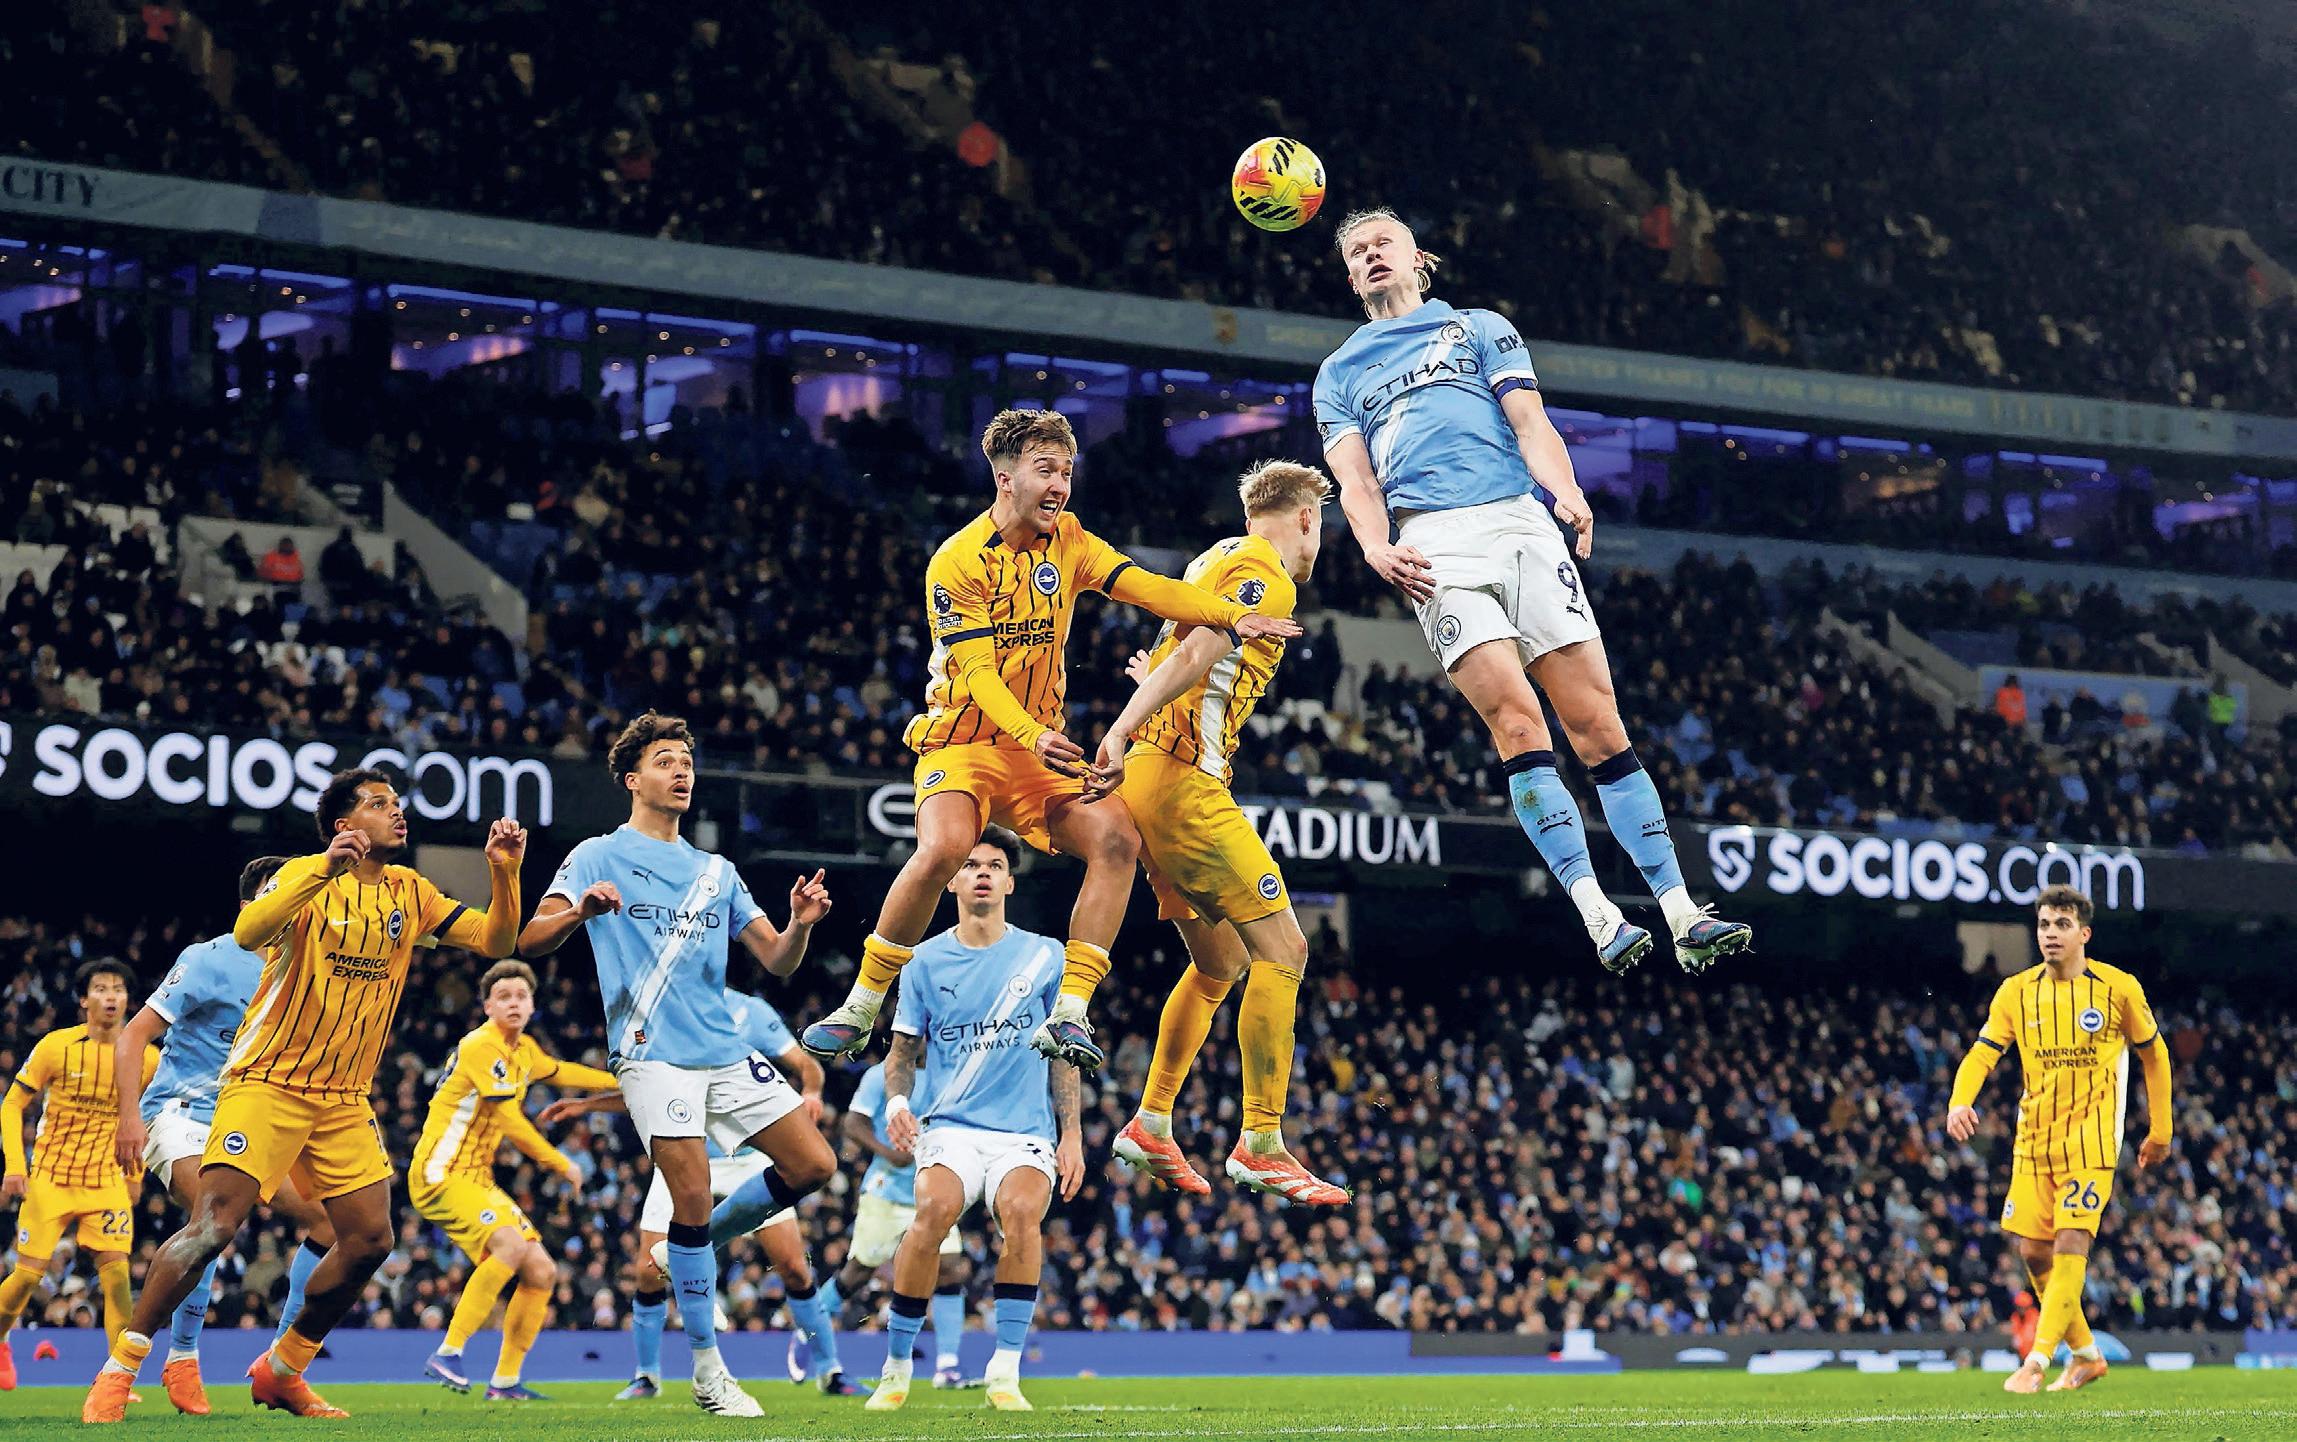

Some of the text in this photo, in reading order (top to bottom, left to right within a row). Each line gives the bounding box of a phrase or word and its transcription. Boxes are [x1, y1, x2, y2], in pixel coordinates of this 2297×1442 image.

[3, 165, 100, 208] CITY
[1362, 357, 1479, 412] ETIHAD
[1557, 561, 1578, 602] 9
[992, 616, 1055, 634] MERICAN
[1242, 804, 1441, 866] TADIUM
[627, 903, 720, 929] ETIHAD
[654, 926, 705, 943] AIRWAYS
[940, 1013, 1033, 1042] ETIHAD
[959, 1036, 1020, 1054] AIRWAYS
[2034, 1046, 2097, 1059] AMERICAN
[748, 1055, 776, 1084] 6
[2043, 1057, 2099, 1070] EXPRESS
[2063, 1180, 2100, 1210] 26
[101, 1209, 131, 1235] 22
